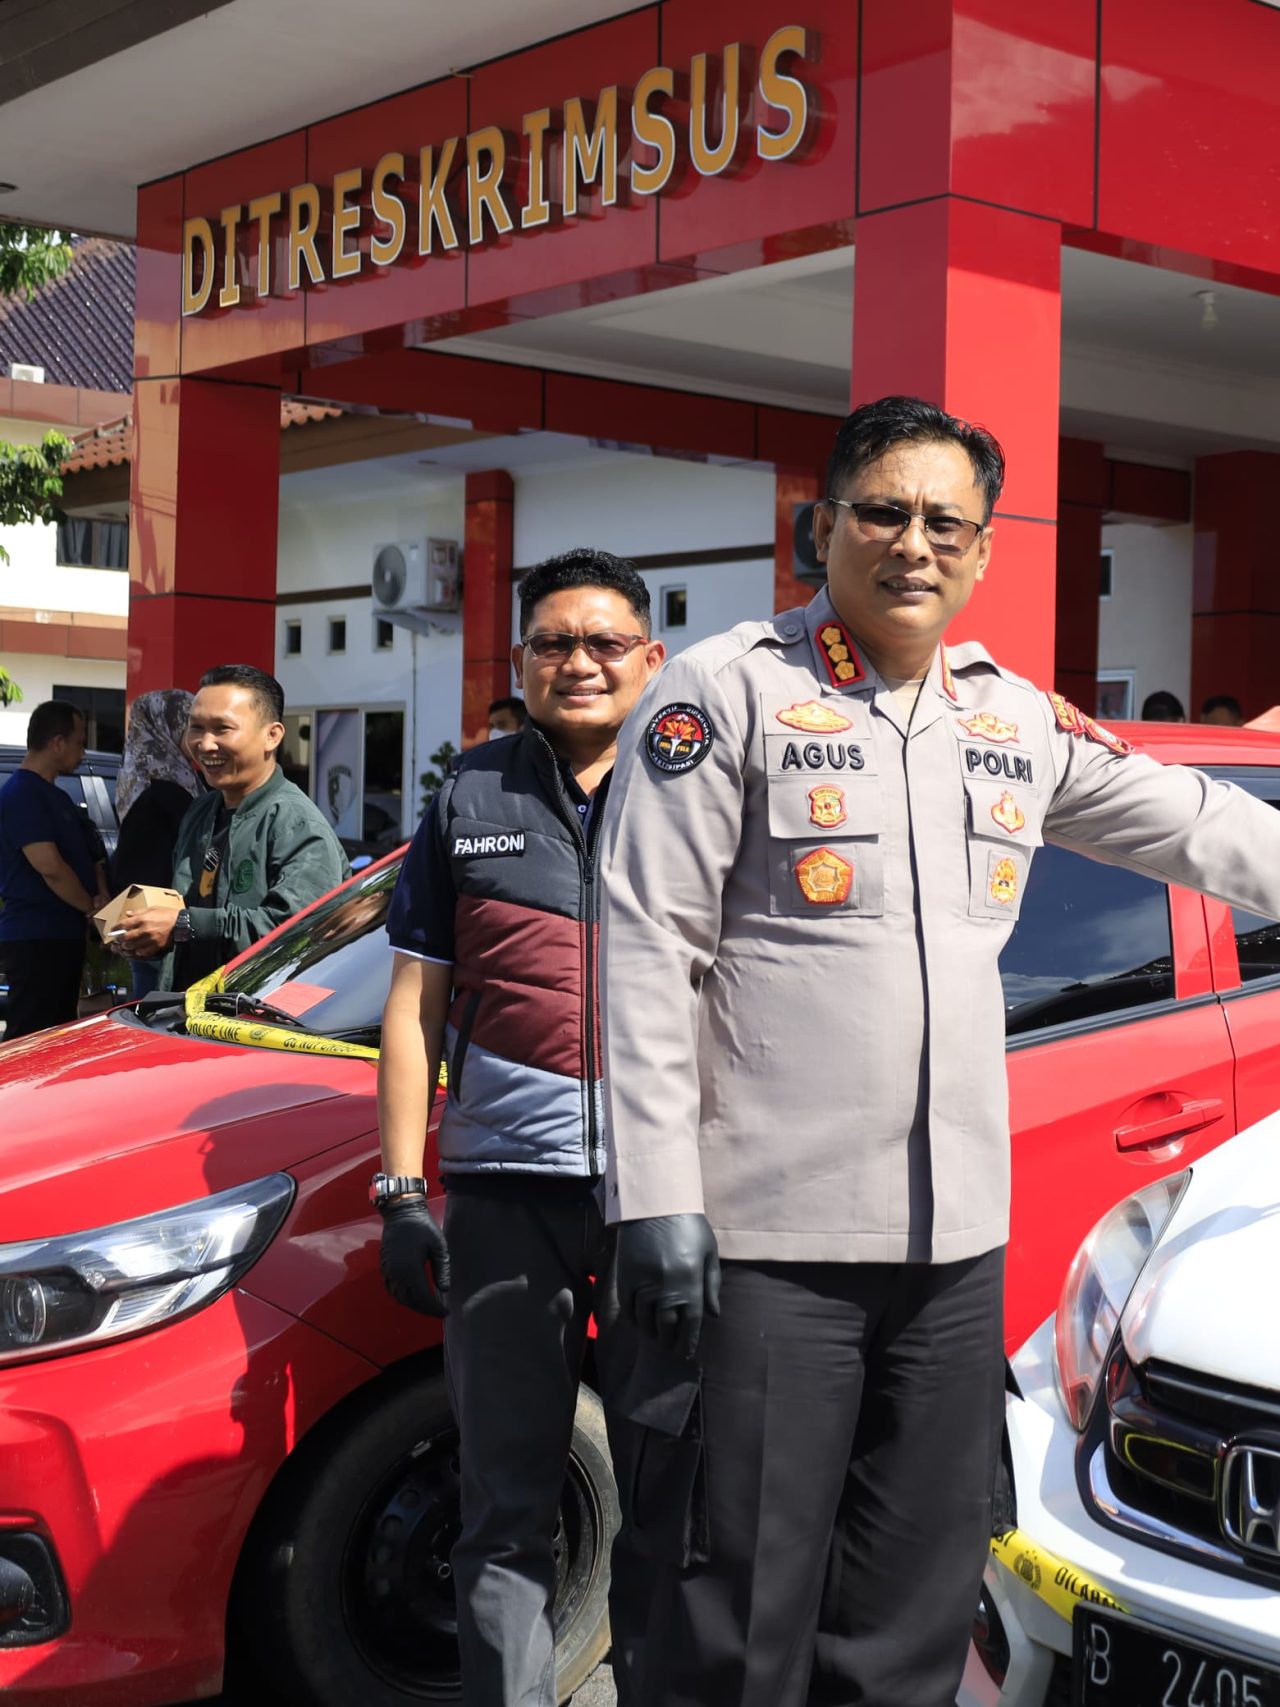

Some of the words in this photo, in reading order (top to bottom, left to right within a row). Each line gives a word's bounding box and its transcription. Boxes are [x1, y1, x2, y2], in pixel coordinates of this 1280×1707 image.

[181, 25, 807, 317] DITRESKRIMSUS
[781, 742, 865, 771] AGUS
[965, 748, 1034, 784] POLRI
[454, 833, 525, 855] FAHRONI
[219, 1024, 242, 1041] LINE
[1089, 1622, 1111, 1686] B
[1161, 1650, 1262, 1707] 2405
